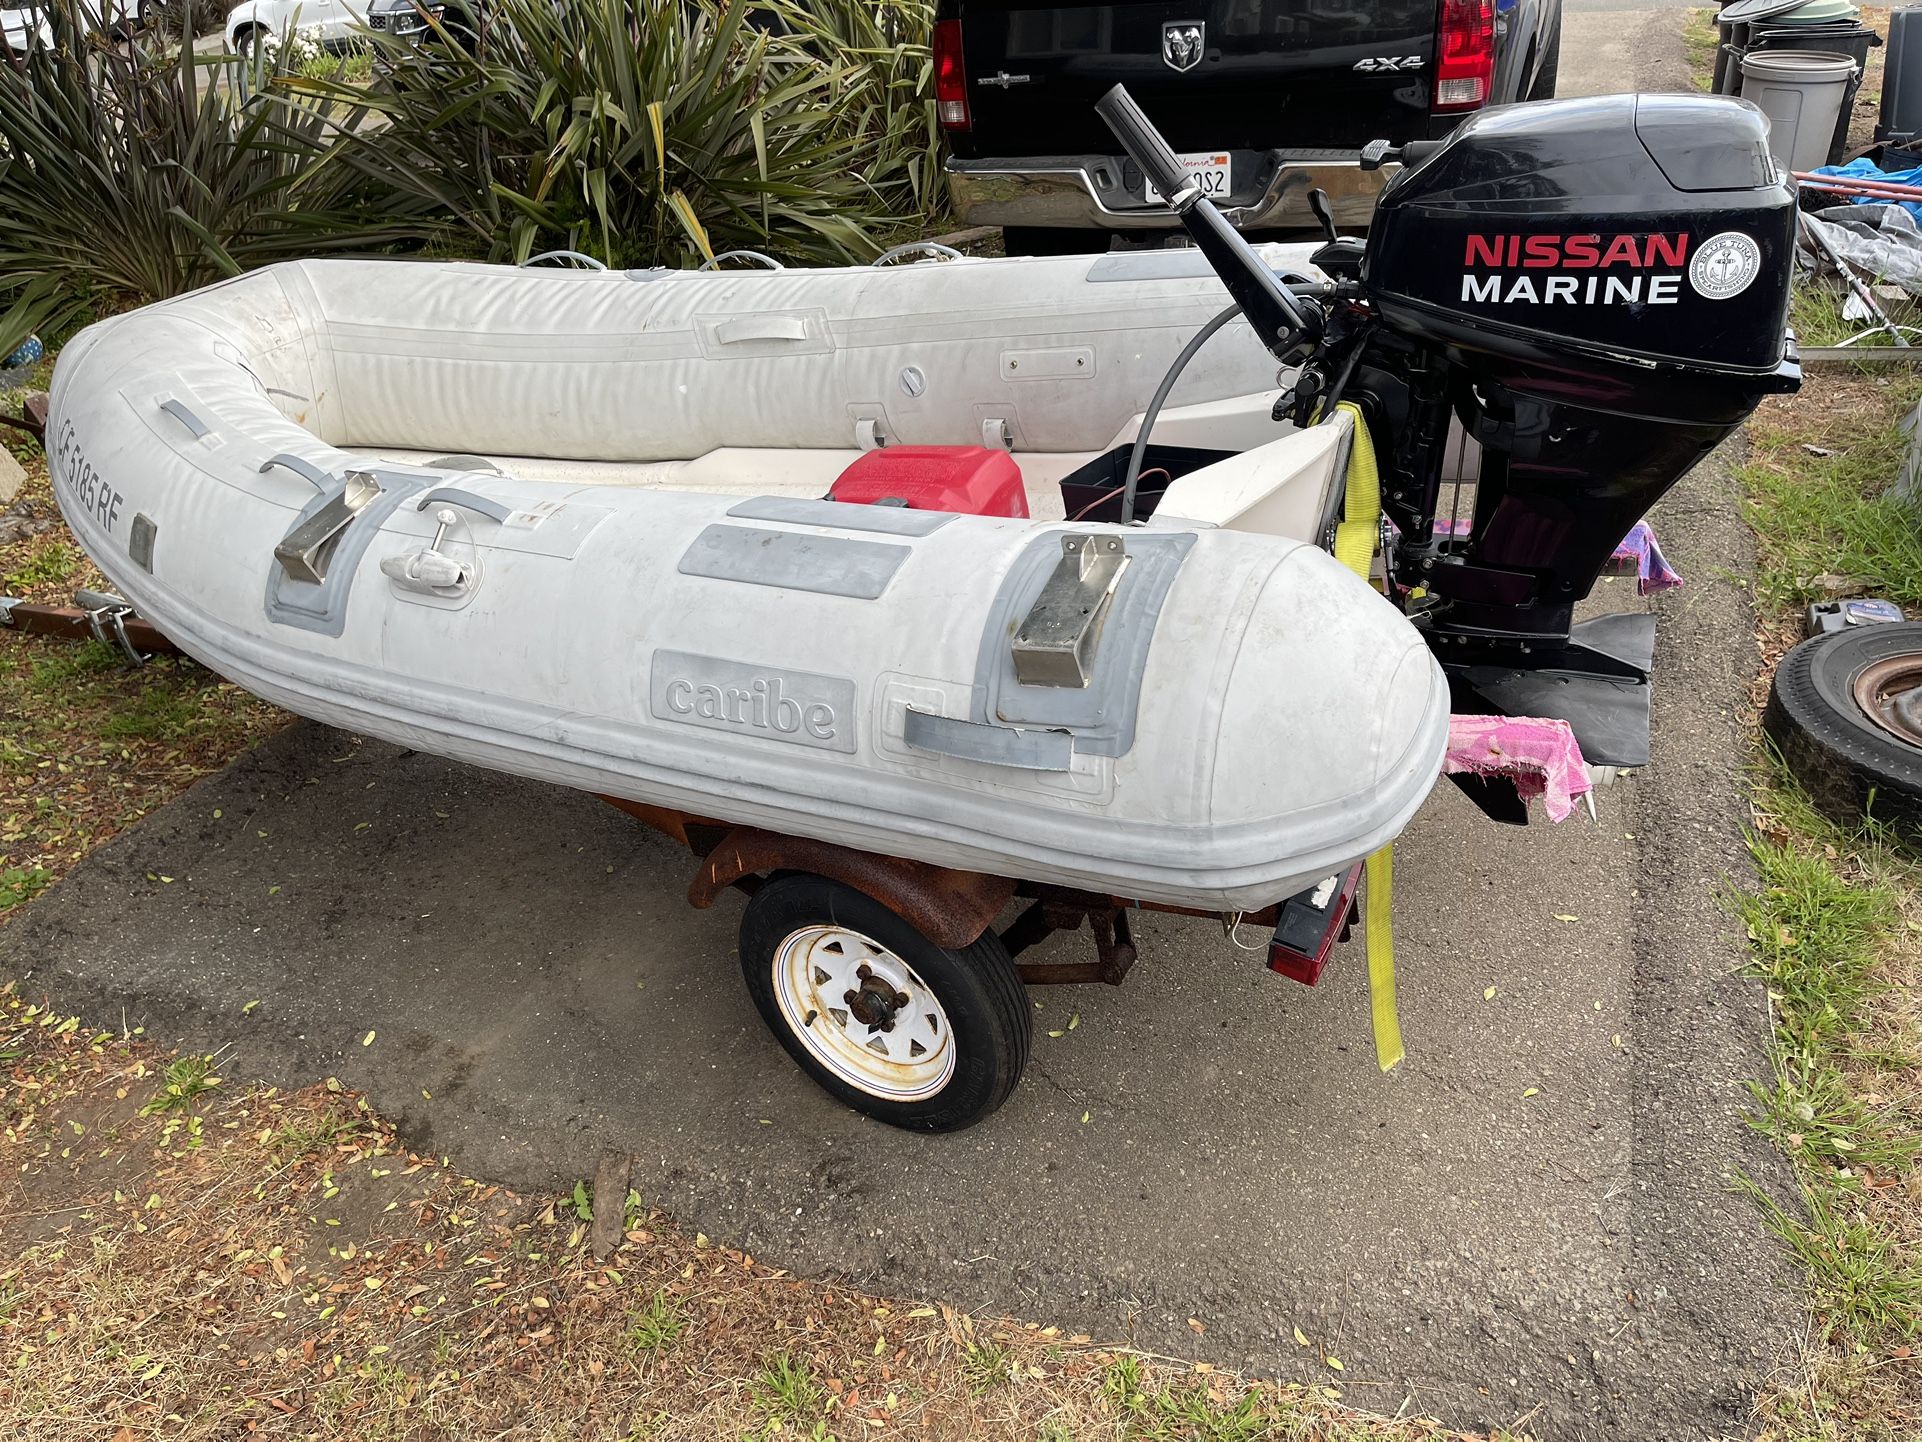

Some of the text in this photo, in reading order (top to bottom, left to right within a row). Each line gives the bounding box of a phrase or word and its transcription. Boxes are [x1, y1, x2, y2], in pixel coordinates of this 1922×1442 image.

[1464, 233, 1689, 268] NISSAN
[1700, 240, 1752, 265] BLUE TUNA
[1461, 274, 1682, 305] MARINE
[59, 418, 124, 533] CF 5185 RF
[666, 677, 837, 740] caribe
